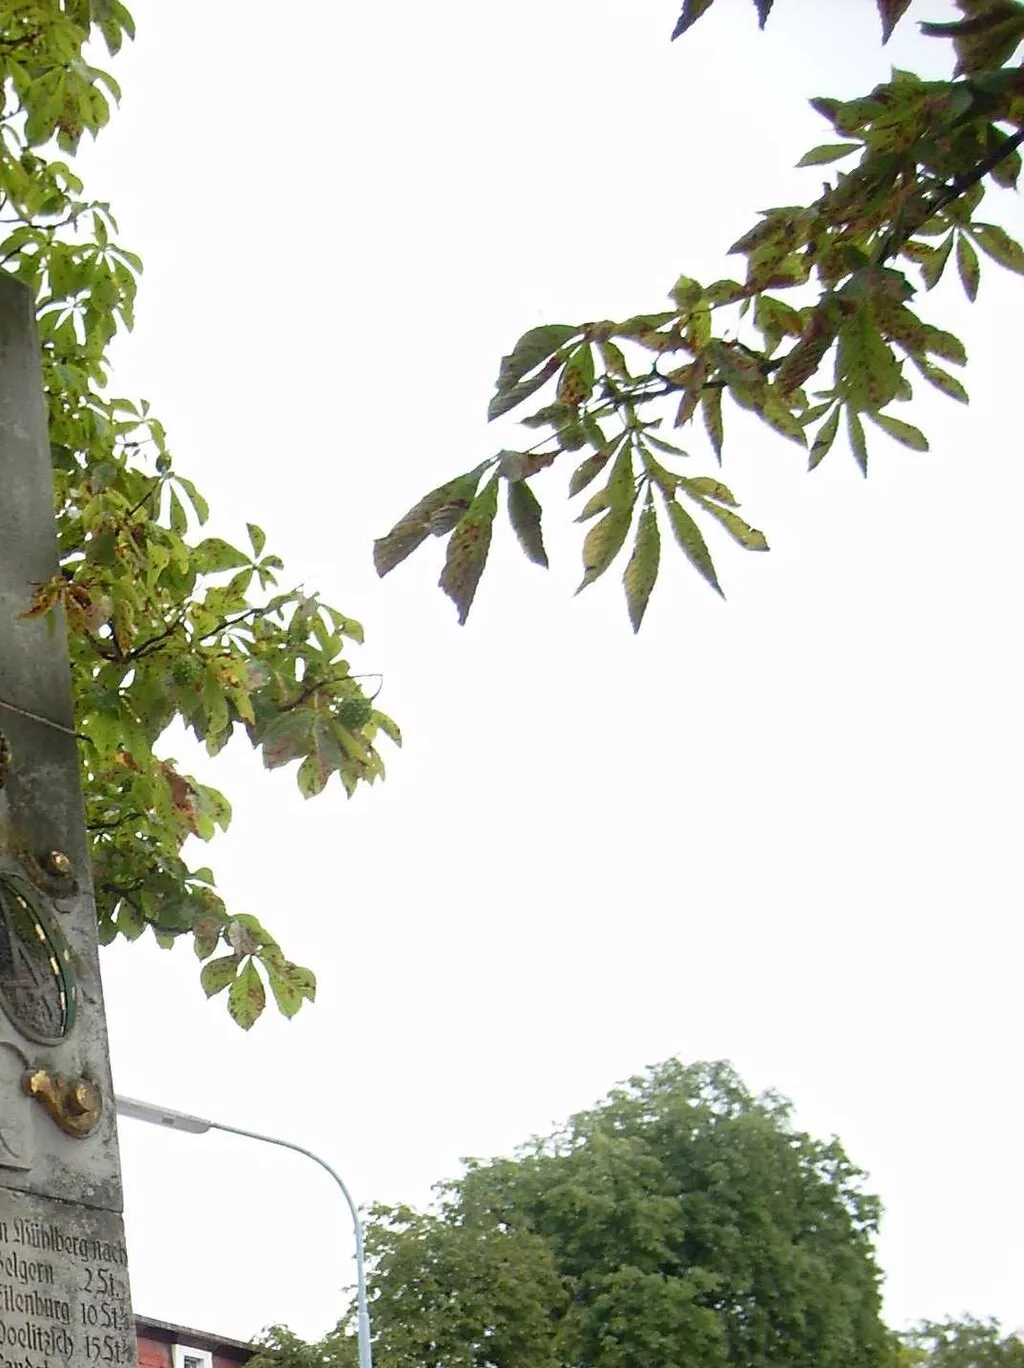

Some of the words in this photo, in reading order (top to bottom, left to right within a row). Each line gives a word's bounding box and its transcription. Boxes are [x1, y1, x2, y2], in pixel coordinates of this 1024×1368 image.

[13, 1217, 89, 1262] Mühlberg
[91, 1239, 128, 1266] nach
[82, 1267, 94, 1293] 2
[80, 1302, 99, 1326] 10
